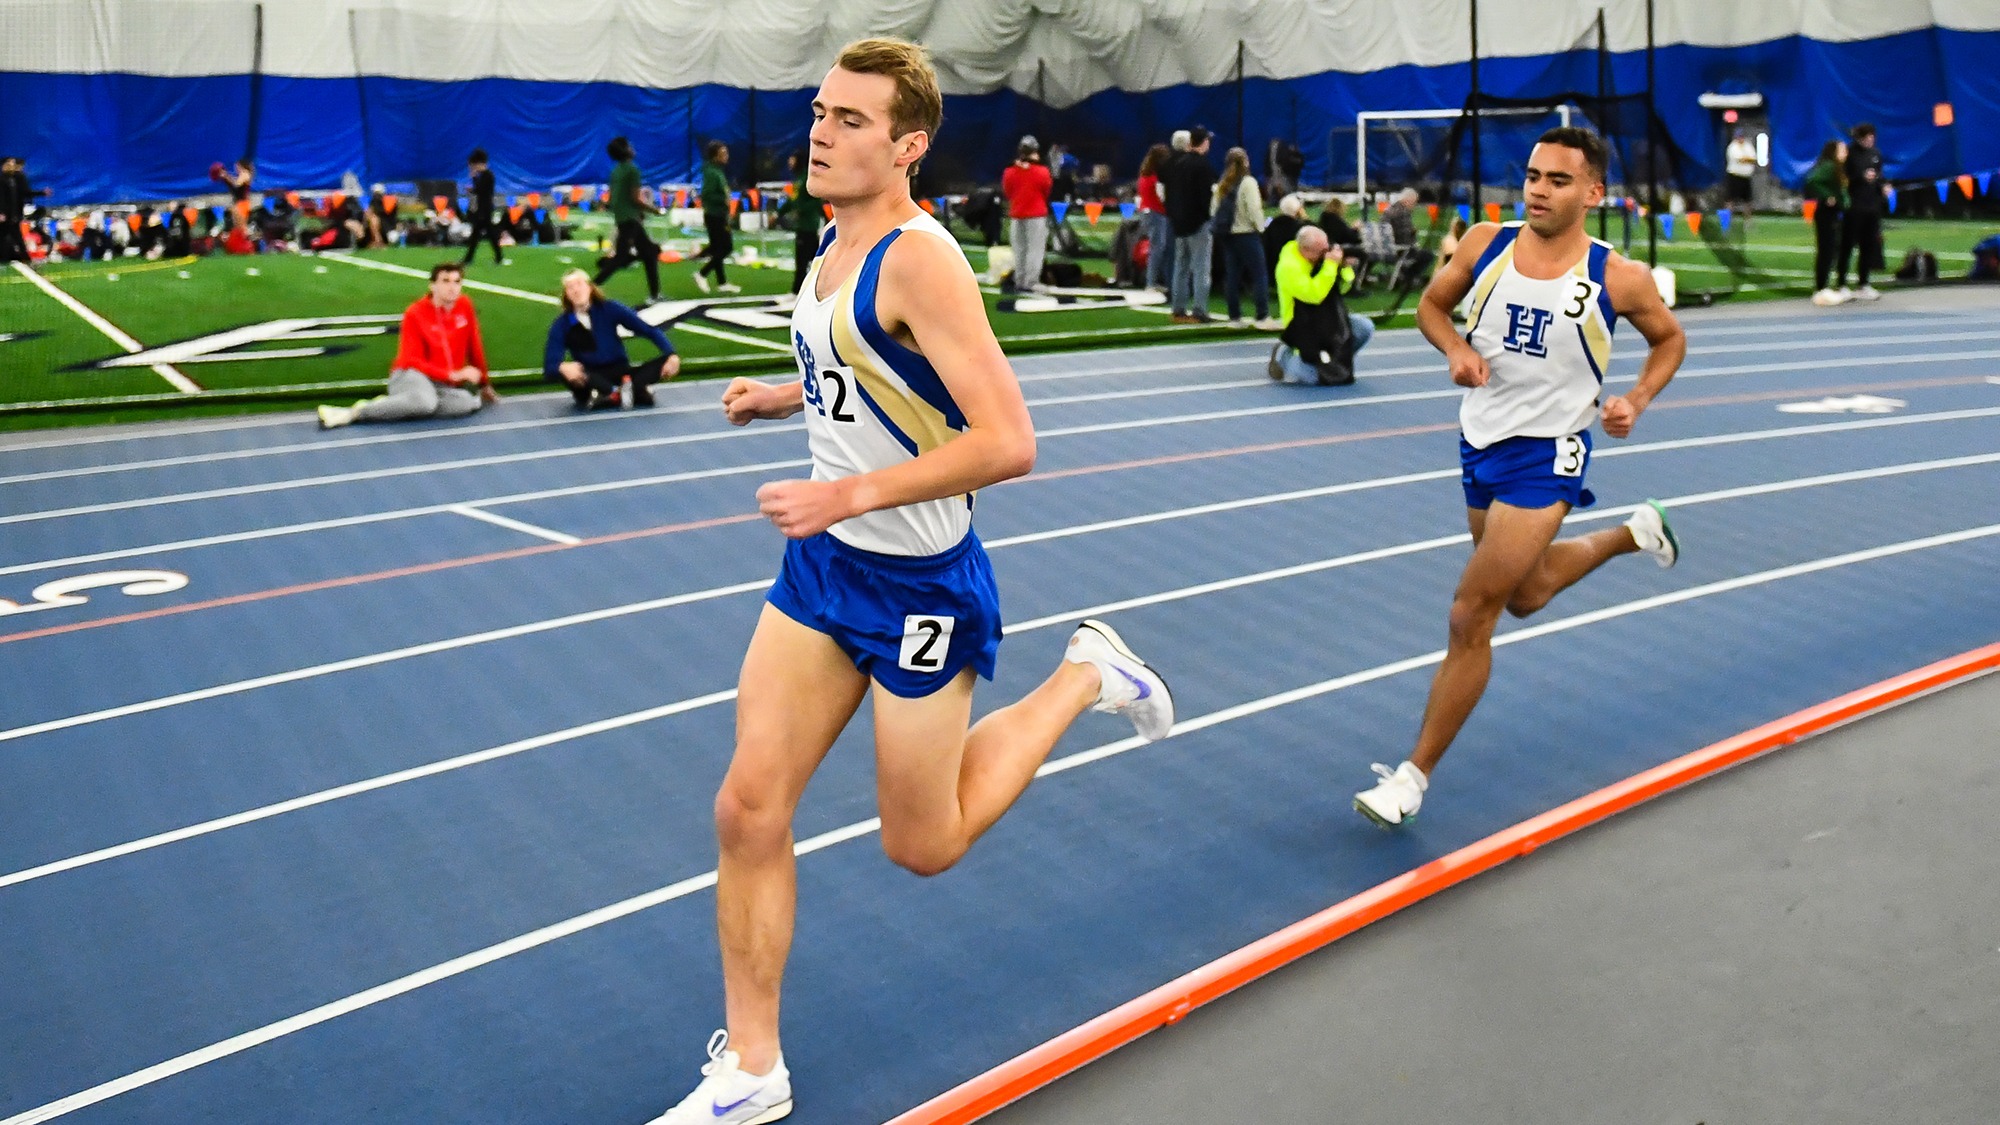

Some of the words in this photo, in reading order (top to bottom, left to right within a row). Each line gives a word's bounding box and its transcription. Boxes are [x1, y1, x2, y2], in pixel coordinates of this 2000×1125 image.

[1563, 281, 1592, 319] 3
[1503, 303, 1554, 359] H
[822, 370, 856, 423] 2
[1563, 437, 1580, 473] 3
[910, 619, 943, 667] 2
